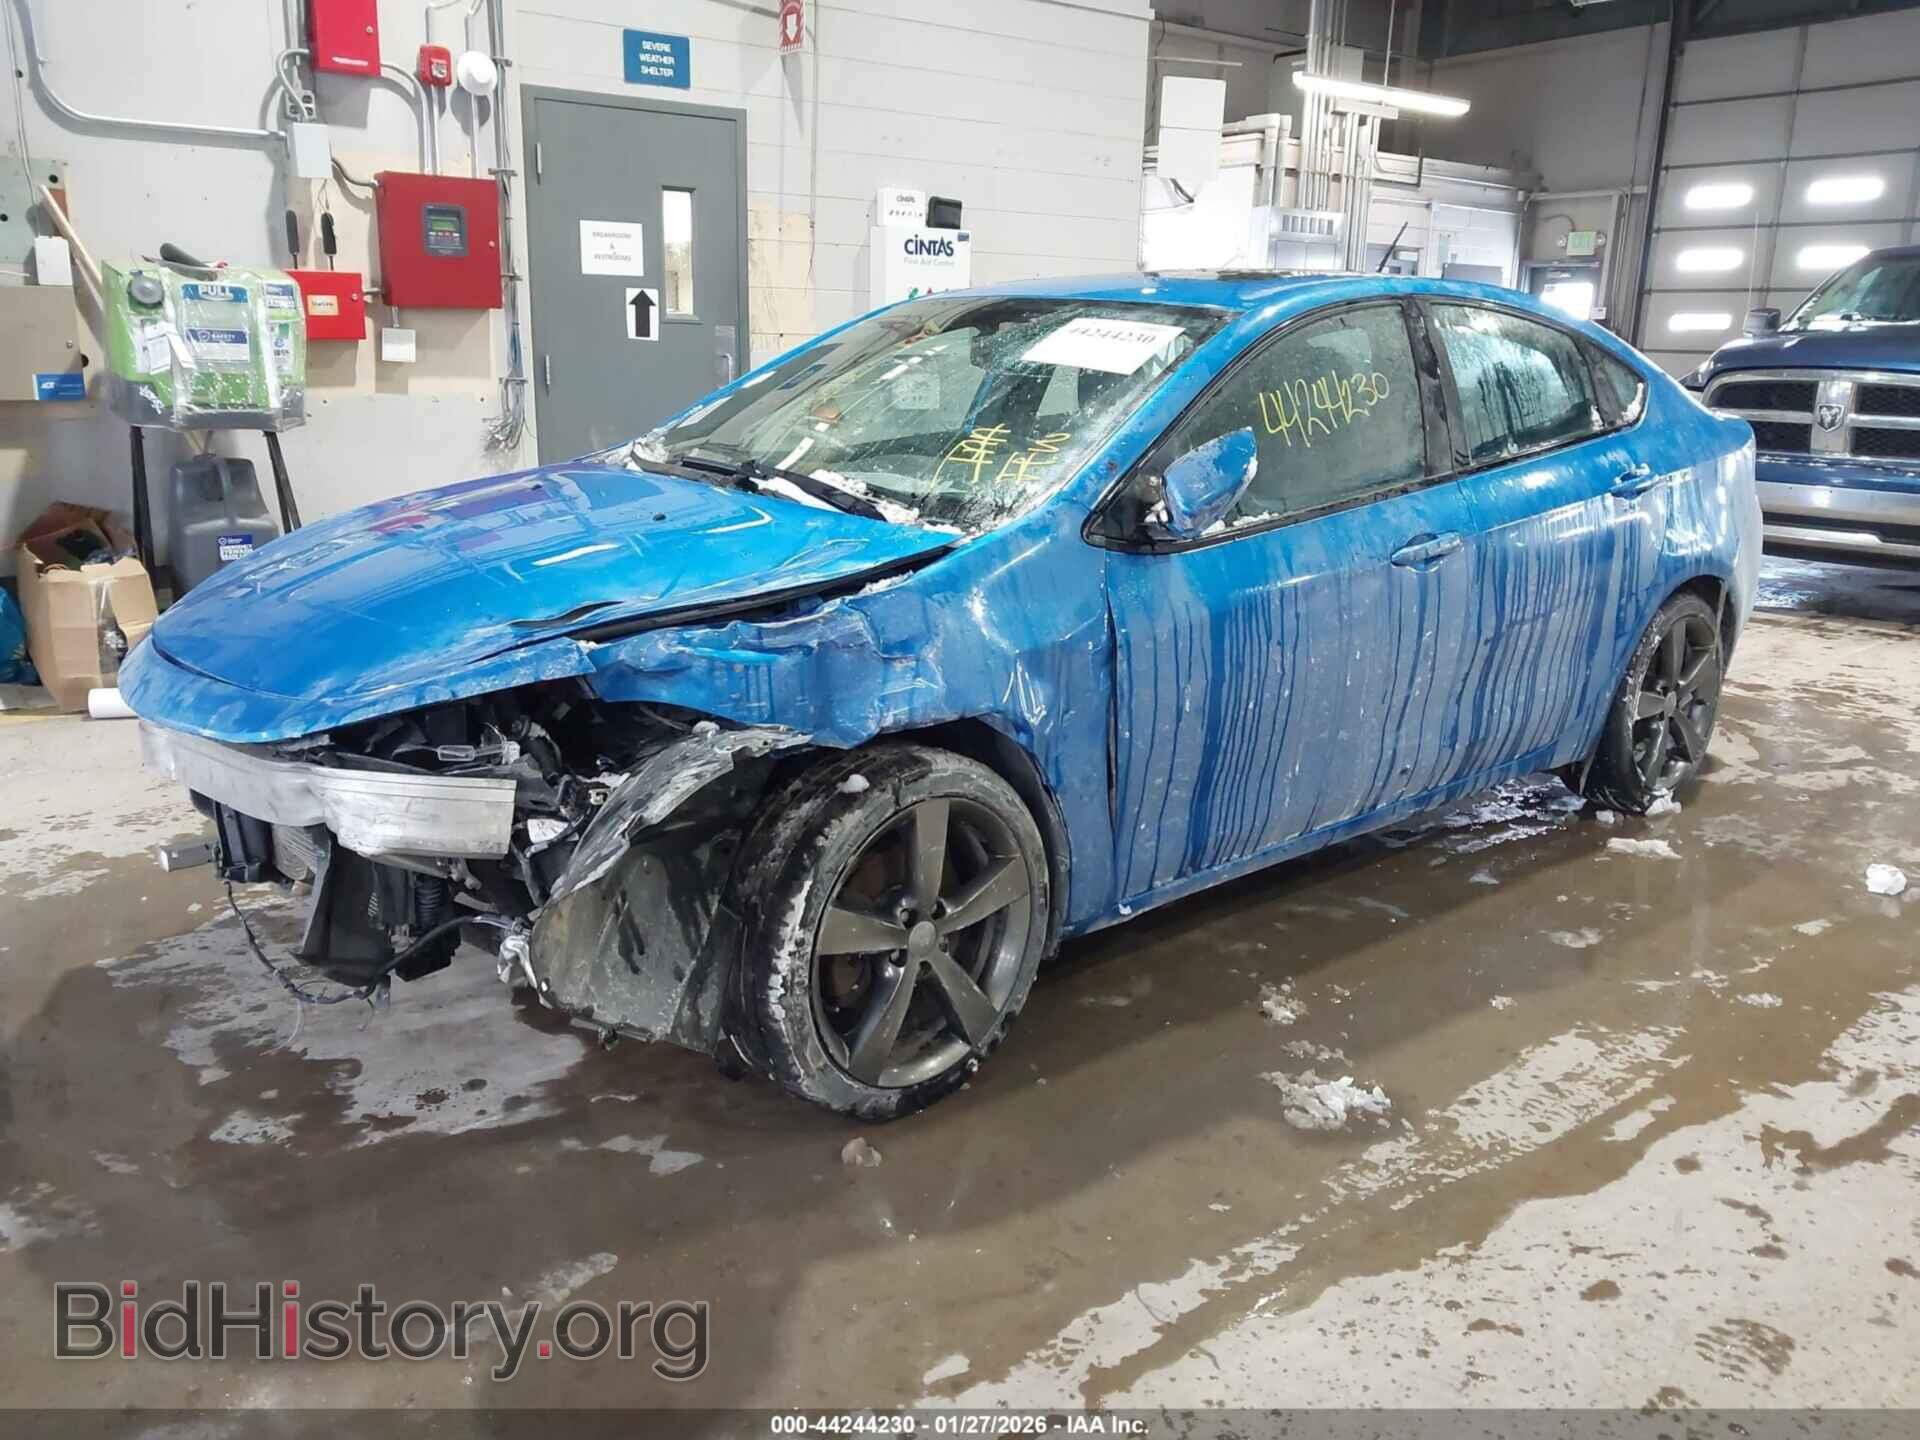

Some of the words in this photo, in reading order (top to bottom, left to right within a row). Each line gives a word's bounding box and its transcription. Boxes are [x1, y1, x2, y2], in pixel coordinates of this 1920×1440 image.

[642, 40, 672, 53] SEVERE
[639, 52, 675, 65] WEATHER
[640, 64, 674, 77] SHELTER
[198, 284, 234, 297] PULL
[1258, 369, 1390, 448] 44244230
